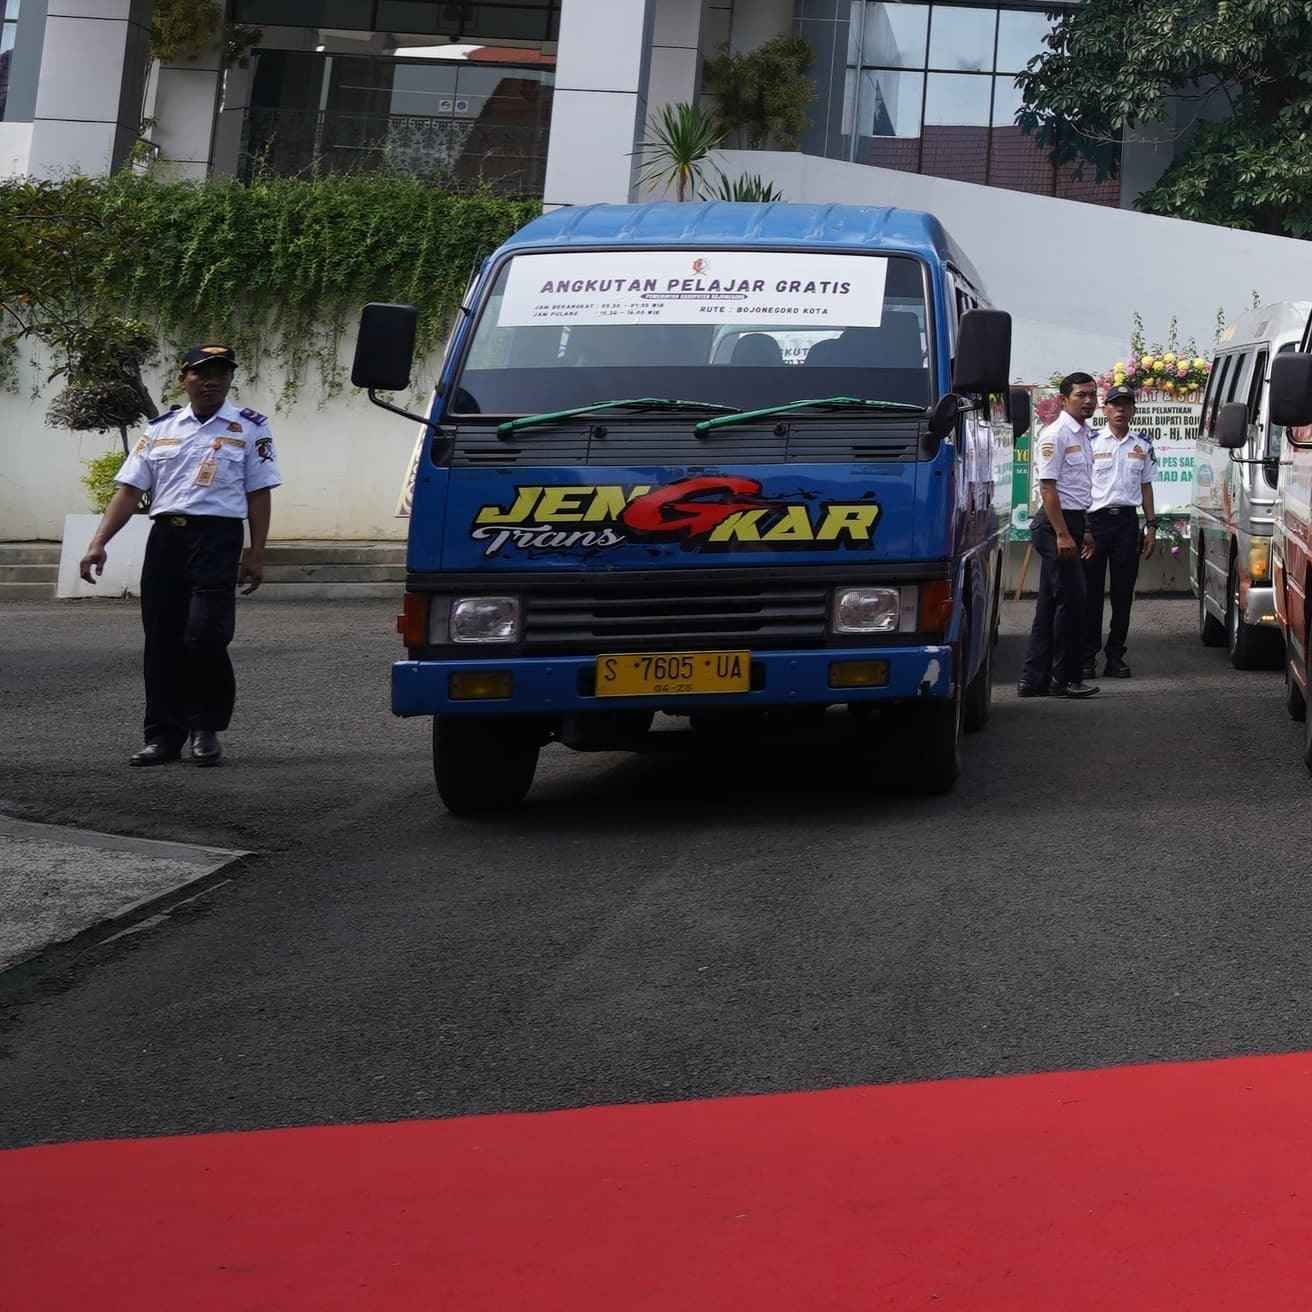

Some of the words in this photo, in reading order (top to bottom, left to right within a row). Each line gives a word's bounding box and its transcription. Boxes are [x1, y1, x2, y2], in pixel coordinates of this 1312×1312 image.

[540, 279, 657, 294] ANGKUTAN
[667, 279, 766, 293] PELAJAR
[775, 280, 851, 294] GRATIS
[736, 306, 799, 314] BOJONEGORO
[802, 307, 829, 315] KOTA
[1152, 406, 1192, 415] PELANTIKAN
[1155, 415, 1182, 426] BUPATI
[1169, 427, 1183, 441] Hj.
[471, 524, 626, 557] Trans
[603, 658, 617, 681] S
[640, 656, 695, 681] 7605
[716, 655, 742, 679] UA
